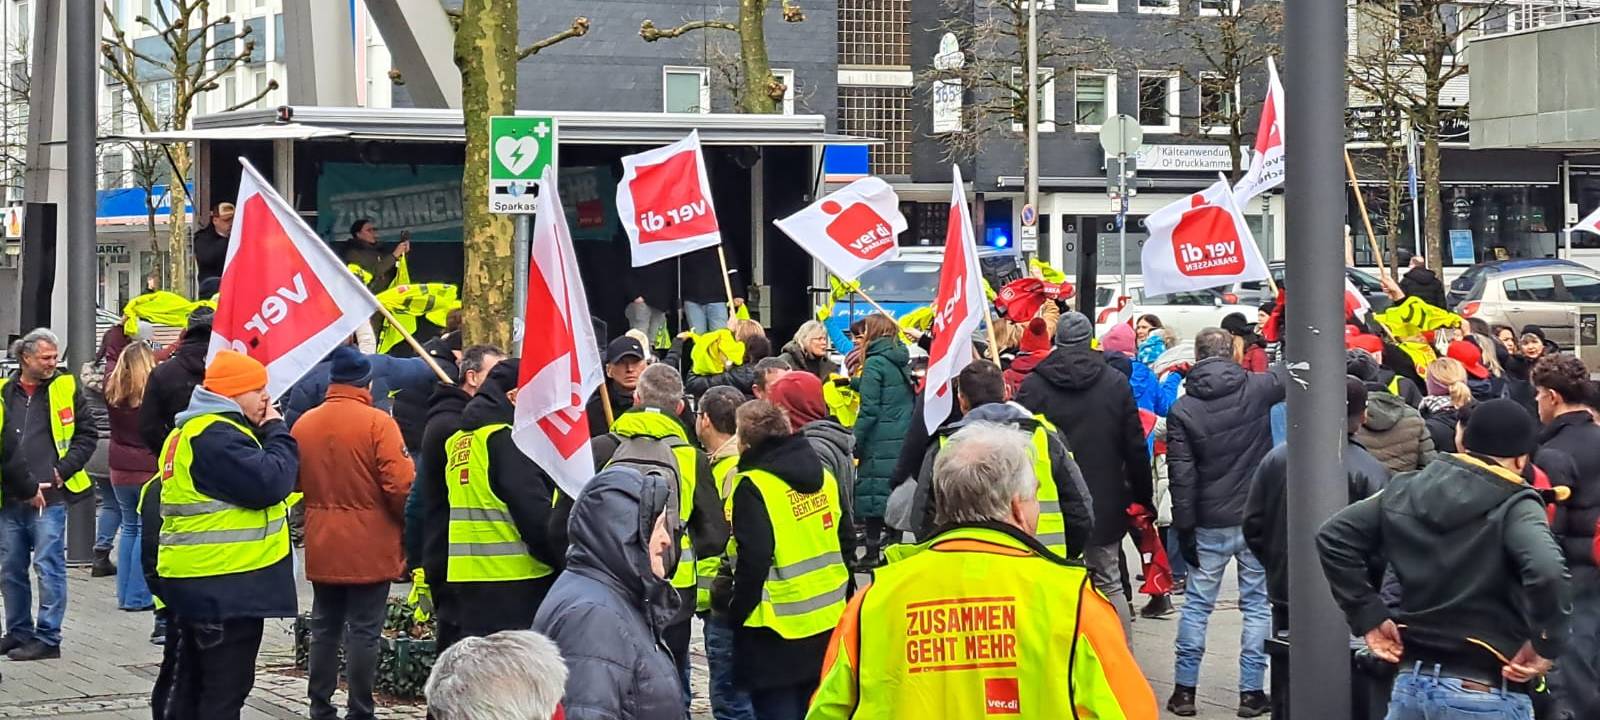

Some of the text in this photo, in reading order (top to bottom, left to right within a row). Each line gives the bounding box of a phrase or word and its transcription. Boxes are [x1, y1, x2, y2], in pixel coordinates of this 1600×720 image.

[1162, 147, 1233, 158] Kälteanwendun
[1175, 159, 1232, 168] Druckkamme
[494, 201, 538, 211] Sparkas
[906, 605, 1015, 637] ZUSAMMEN
[906, 634, 1017, 664] GEHT MEHR
[987, 699, 1018, 710] ver.di
